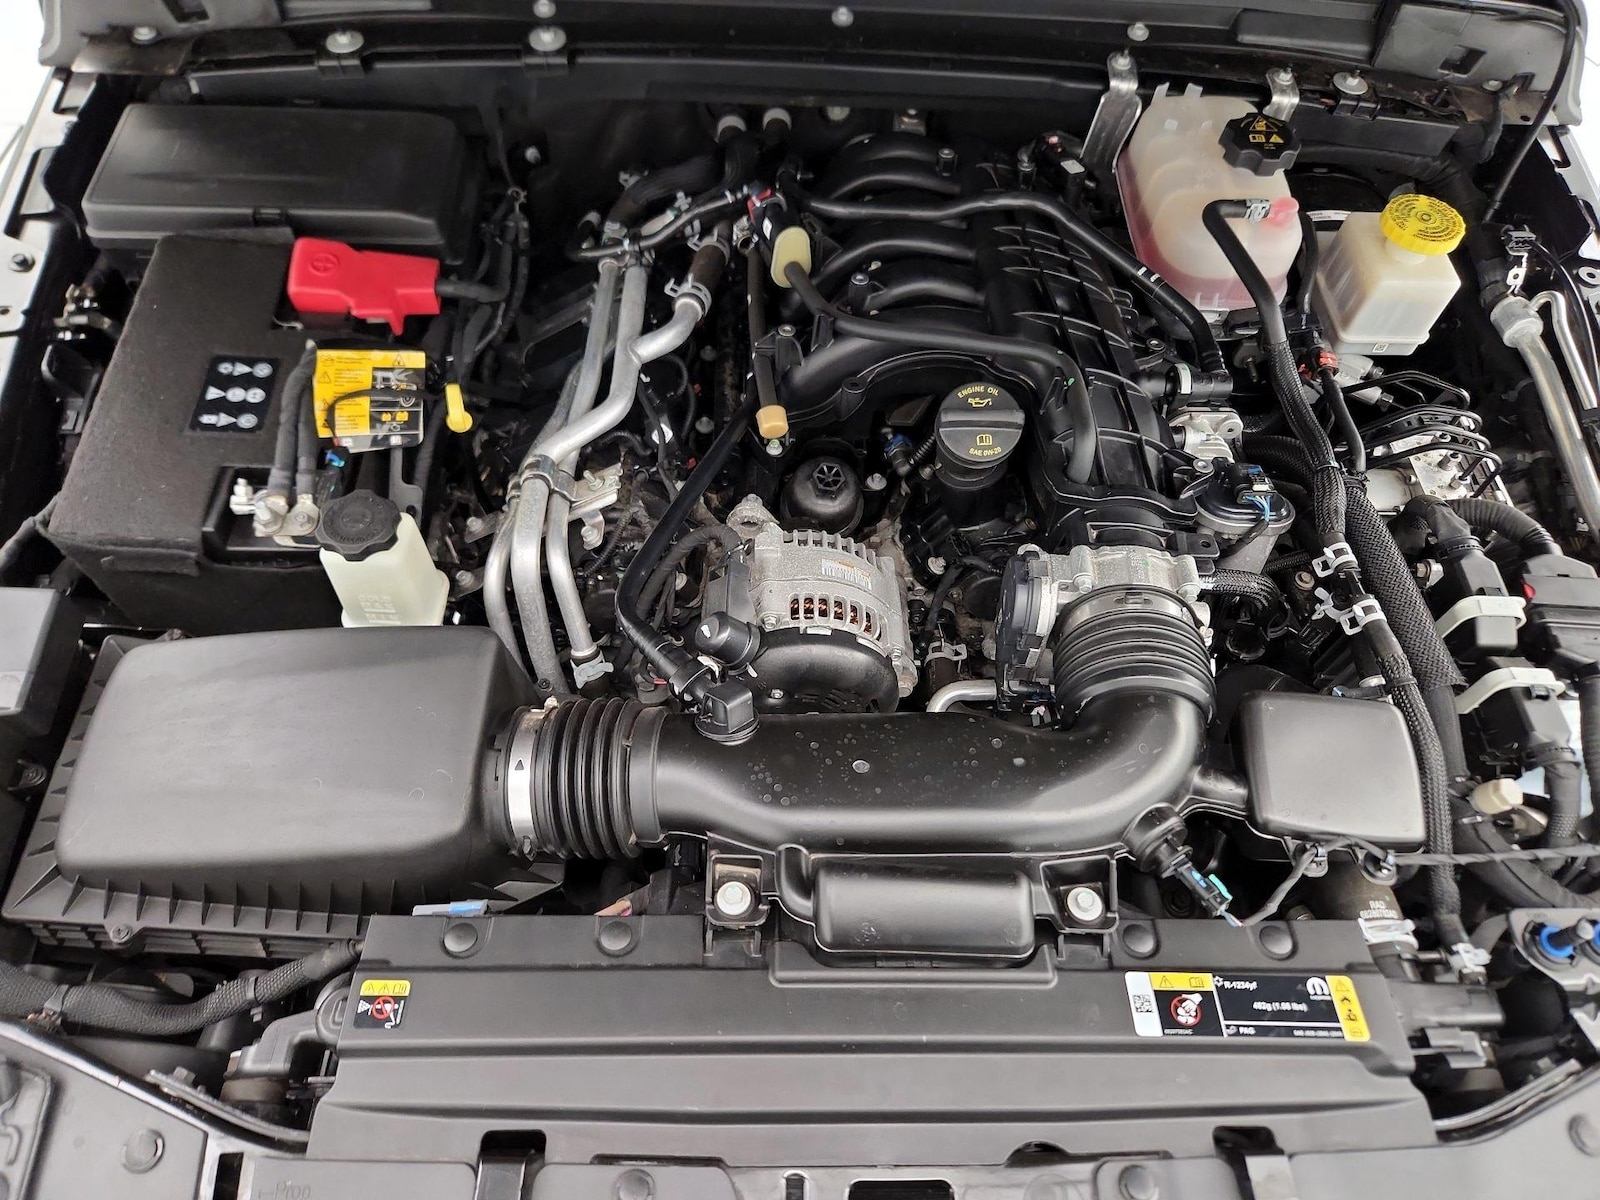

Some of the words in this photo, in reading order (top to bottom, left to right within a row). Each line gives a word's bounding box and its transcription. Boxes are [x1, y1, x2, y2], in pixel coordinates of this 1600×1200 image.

[957, 385, 985, 399] ENGINE
[987, 386, 1000, 396] OIL
[968, 447, 982, 456] SAE
[1369, 900, 1386, 909] RAD
